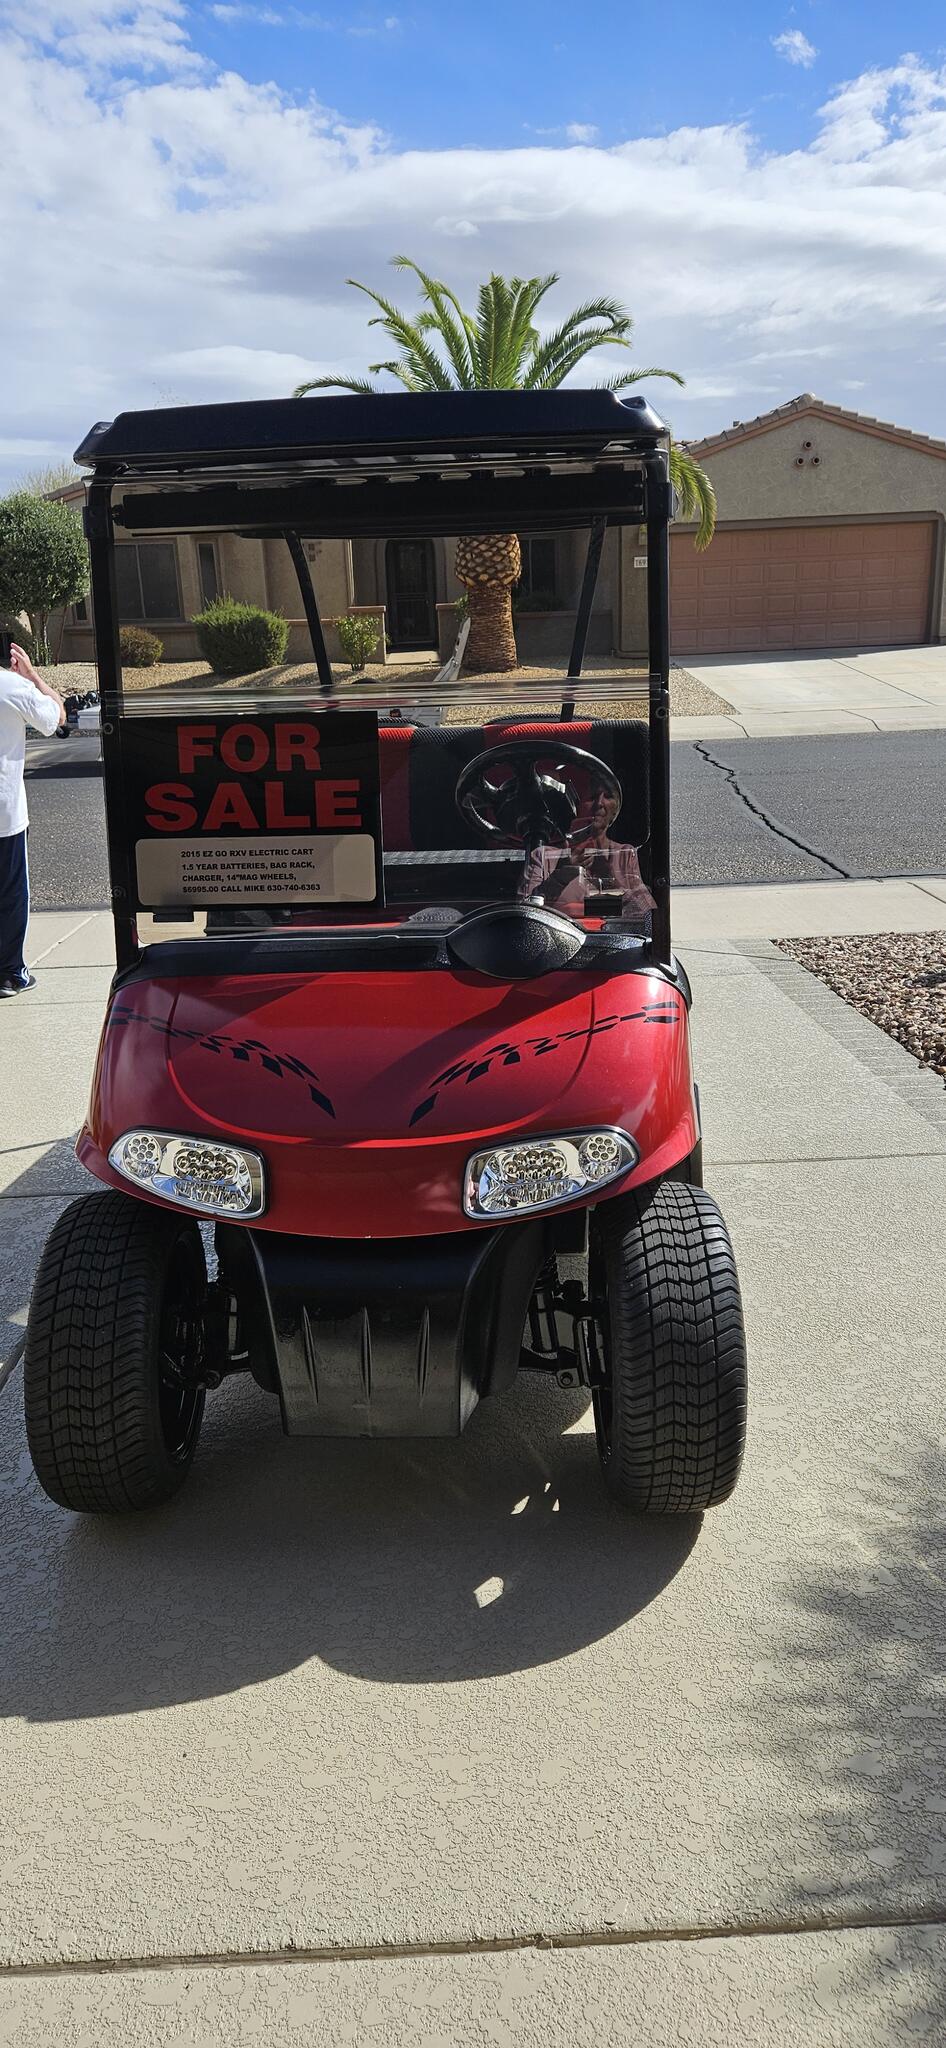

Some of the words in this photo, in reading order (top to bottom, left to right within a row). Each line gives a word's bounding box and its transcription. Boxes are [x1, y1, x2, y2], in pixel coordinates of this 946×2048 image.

[176, 723, 322, 774] FOR
[144, 779, 363, 833] SALE
[180, 850, 201, 858] 2015
[230, 849, 247, 857] RXV
[249, 849, 289, 857] ELECTRIC
[291, 848, 314, 856] CART
[182, 863, 194, 871] 1.5
[220, 862, 269, 871] BATTERIES,
[289, 861, 315, 869] RACK,
[182, 874, 224, 883] CHARGER,
[260, 873, 297, 881] WHEELS,
[221, 885, 242, 893] CALL
[244, 884, 265, 892] MIKE
[267, 883, 321, 892] 630-740-6363
